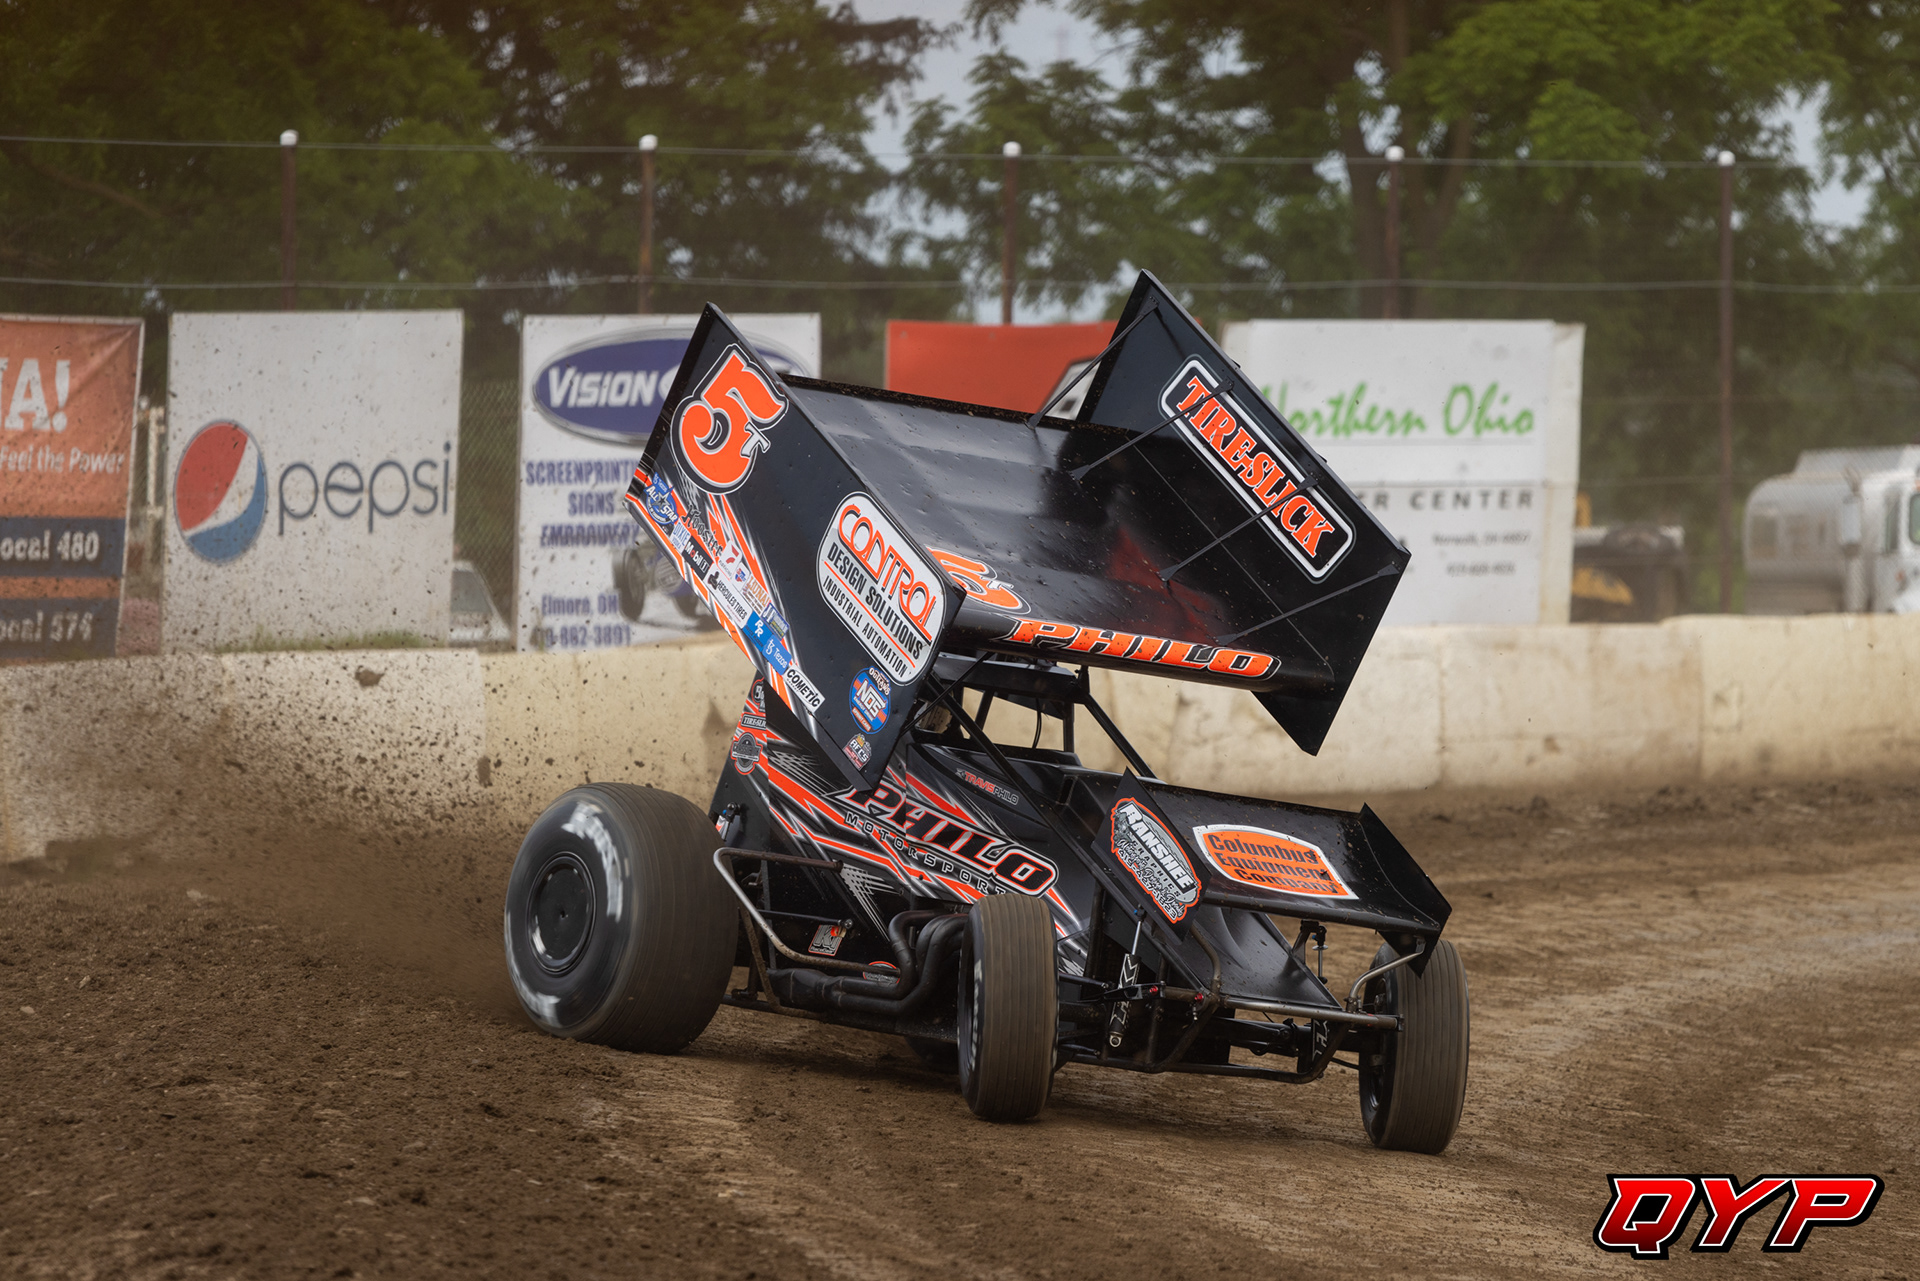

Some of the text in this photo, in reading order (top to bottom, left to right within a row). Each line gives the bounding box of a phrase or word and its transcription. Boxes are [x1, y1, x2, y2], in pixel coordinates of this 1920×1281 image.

[1443, 381, 1534, 437] Ohio
[37, 444, 65, 472] the
[69, 446, 125, 474] Power
[1177, 376, 1336, 558] TIRE-SLICK
[278, 440, 451, 536] pepsi
[568, 491, 615, 516] SIGNS
[646, 485, 659, 502] ALL
[660, 504, 678, 522] STAR
[1408, 490, 1534, 511] CENTER
[57, 530, 99, 562] 480
[540, 522, 640, 548] EMBROIDERY
[681, 503, 723, 557] Hoosier
[684, 540, 710, 574] Mobil 1
[838, 504, 936, 646] CONTROL
[597, 593, 619, 615] OH
[717, 580, 736, 607] HERCULES
[733, 602, 748, 620] TIRES
[827, 542, 923, 660] DESIGN SOLUTIONS
[823, 575, 908, 678] INDUSTRIAL AUTOMATION
[773, 647, 788, 668] Tezos
[1004, 617, 1279, 678] PHILO
[786, 668, 820, 708] COMETIC
[856, 678, 887, 718] NOS
[845, 782, 1056, 892] PHILO
[1207, 833, 1318, 865] Columbus
[1132, 840, 1181, 897] GRAPHICS
[1234, 868, 1339, 894] Company
